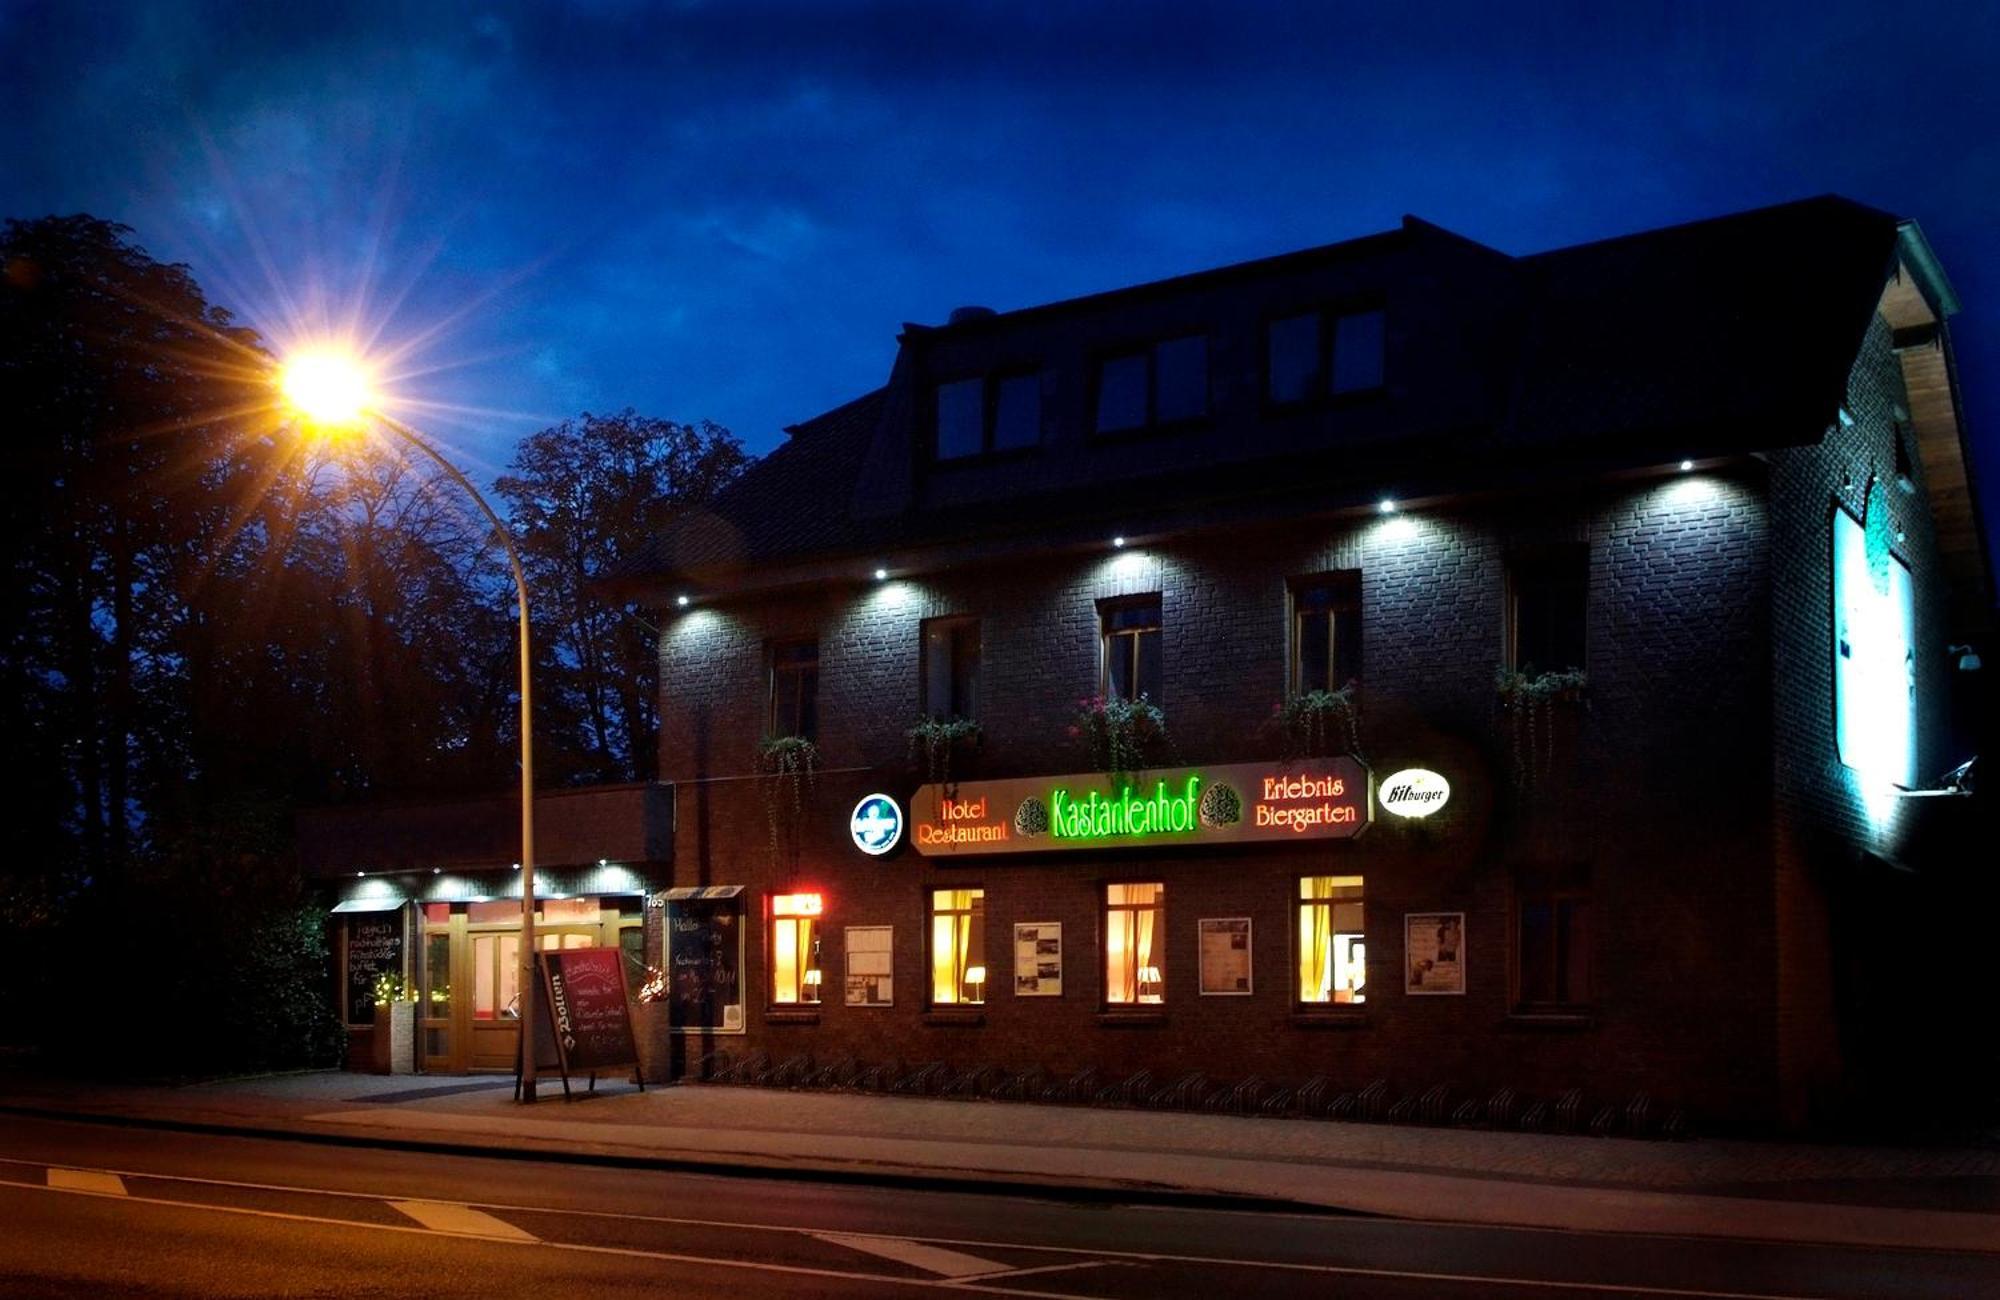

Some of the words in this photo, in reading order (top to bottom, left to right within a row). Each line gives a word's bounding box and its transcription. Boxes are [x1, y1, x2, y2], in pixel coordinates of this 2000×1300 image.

[1264, 774, 1344, 800] Erlebnis
[1387, 785, 1444, 803] Bitburger
[942, 798, 985, 820] Hotel
[1054, 777, 1199, 837] Kastanienhof
[1256, 803, 1355, 832] Biergarten
[919, 821, 1008, 844] Restaurant
